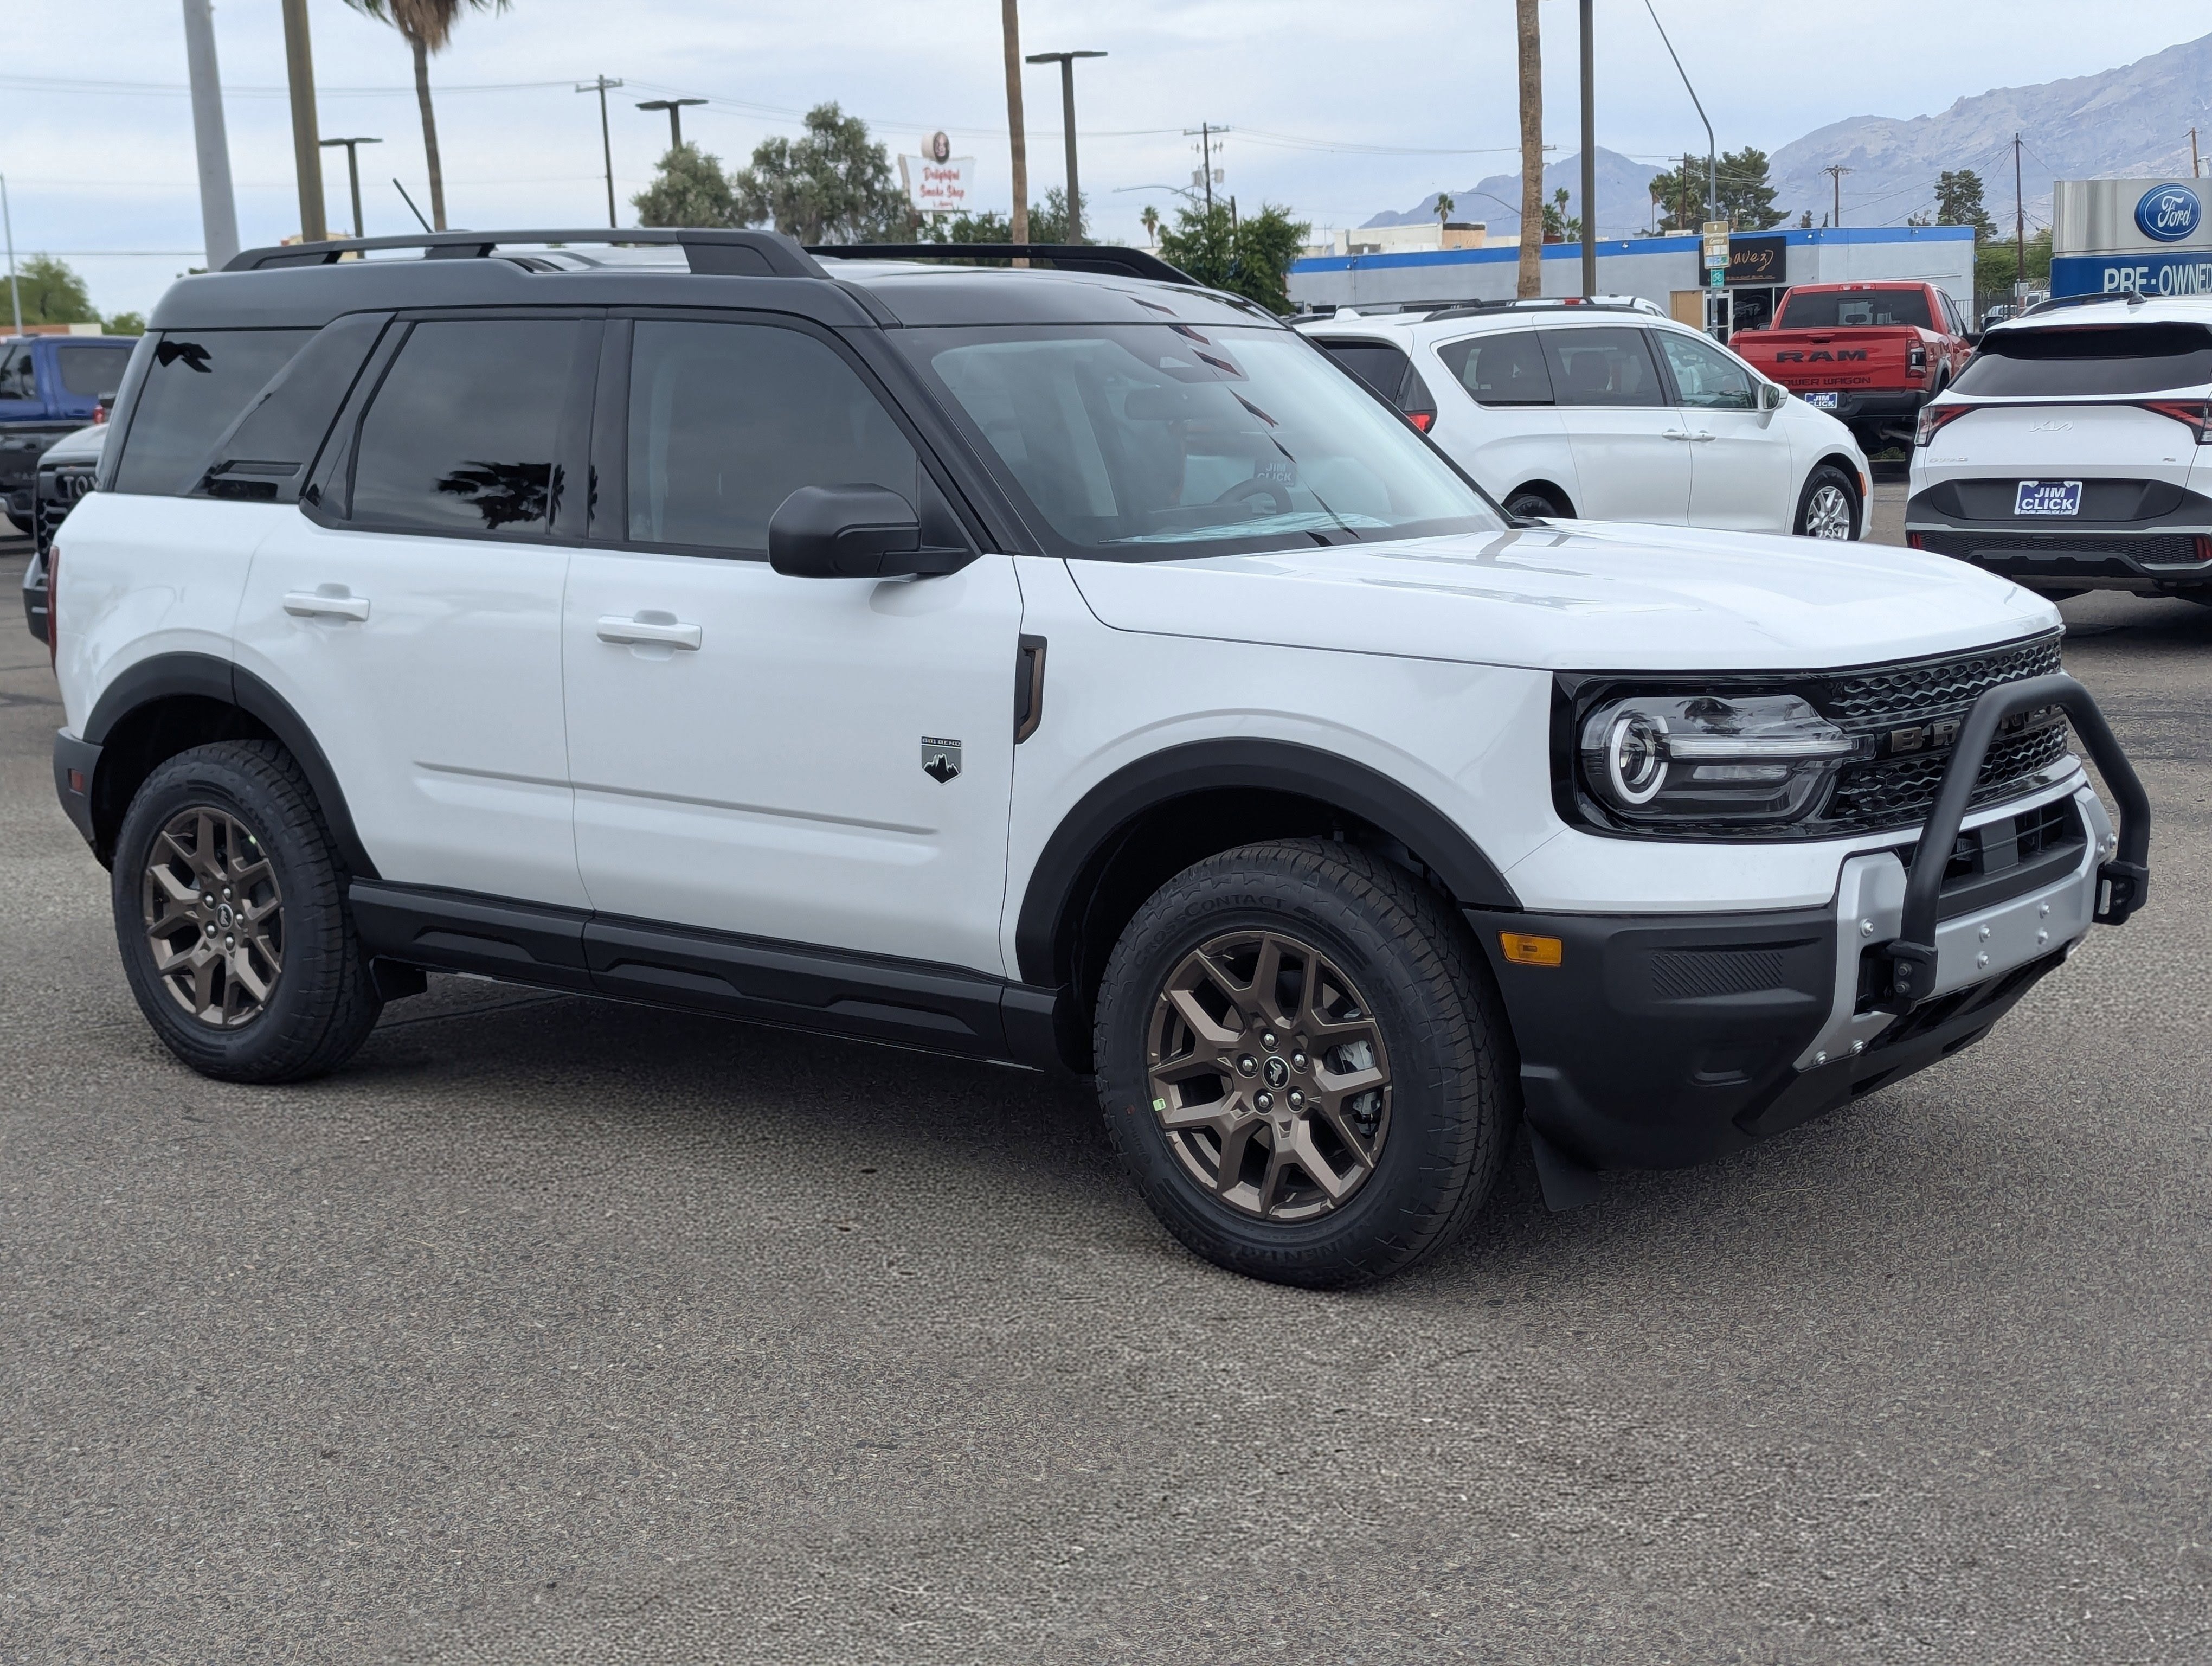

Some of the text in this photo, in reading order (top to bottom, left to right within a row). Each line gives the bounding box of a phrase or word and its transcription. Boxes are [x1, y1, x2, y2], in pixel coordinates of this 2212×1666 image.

[2158, 196, 2191, 228] Ford
[1728, 249, 1774, 272] avez
[1777, 350, 1867, 363] RAM
[1824, 377, 1871, 385] WAGON
[2034, 487, 2067, 498] JIM
[2021, 498, 2074, 510] CLICK
